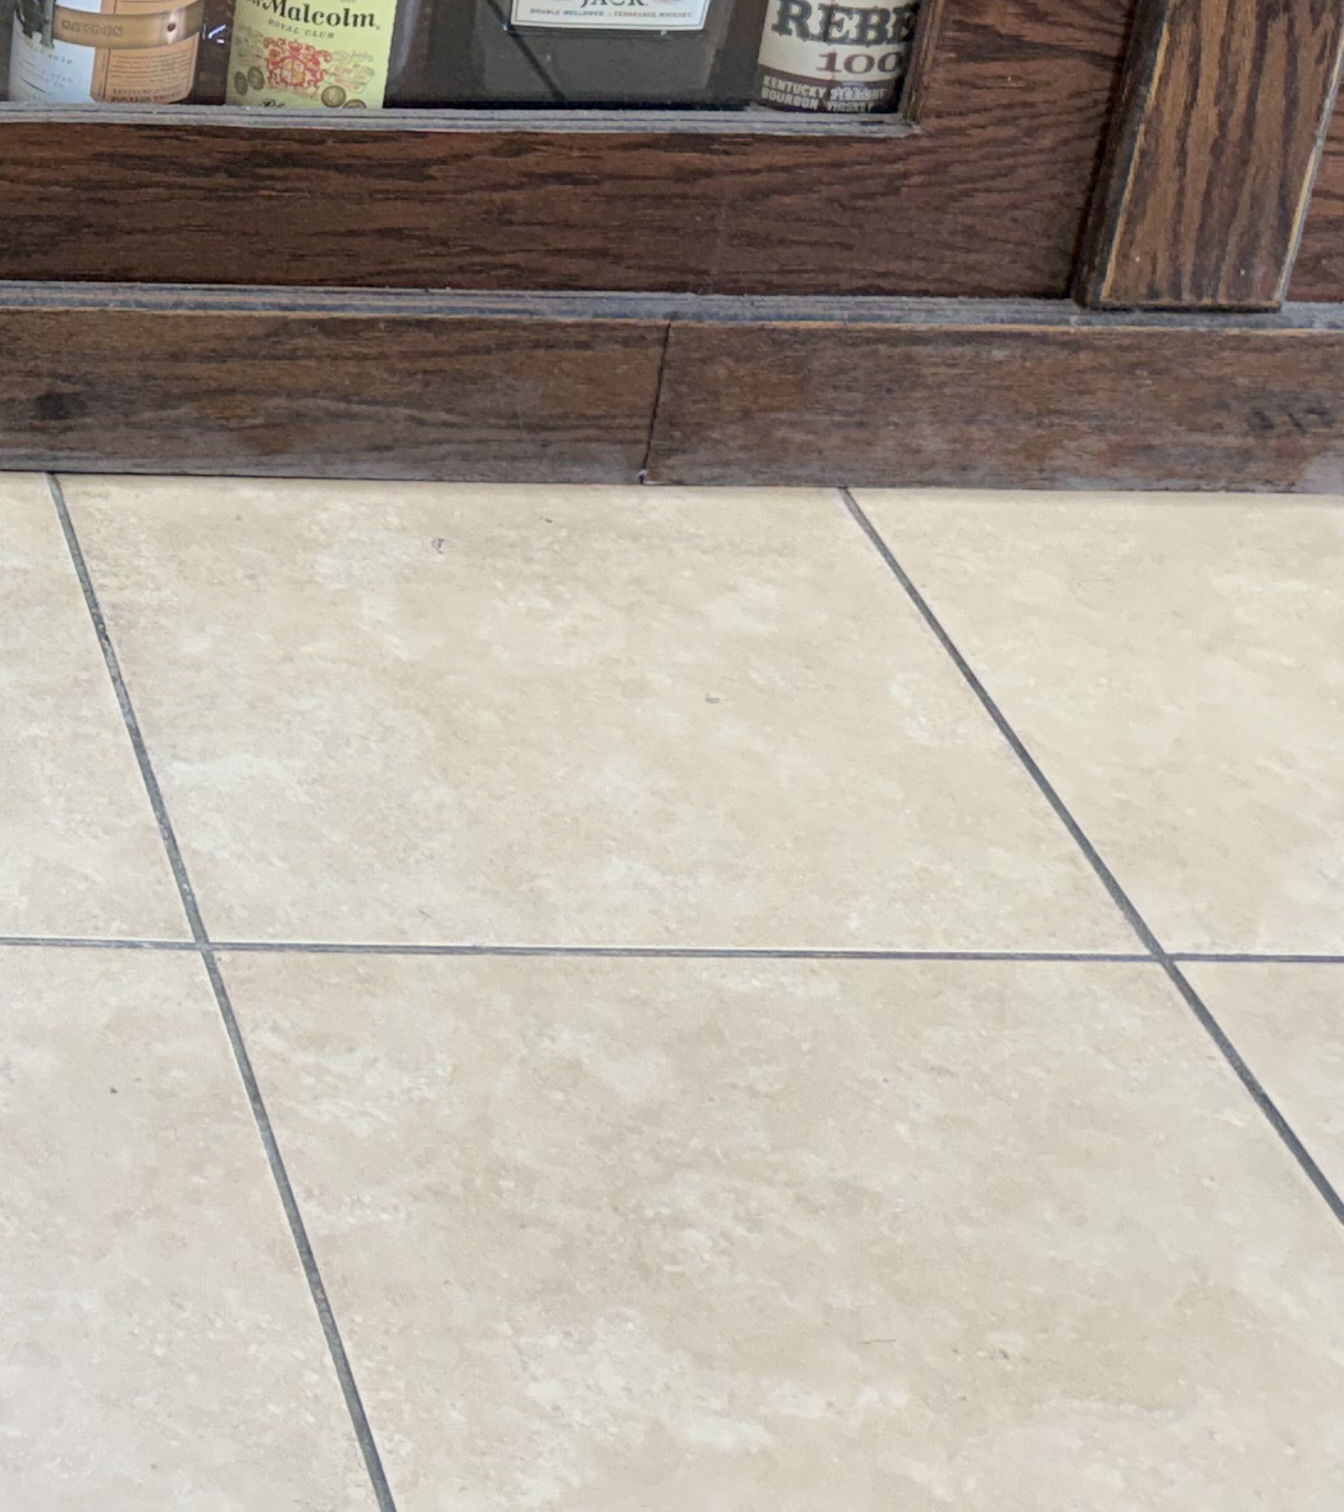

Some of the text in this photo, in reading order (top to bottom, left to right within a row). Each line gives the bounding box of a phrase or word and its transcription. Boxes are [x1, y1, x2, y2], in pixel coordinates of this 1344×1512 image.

[268, 18, 336, 39] ROYAL CLUB
[816, 51, 904, 75] 100
[762, 74, 828, 99] KENTUCKY
